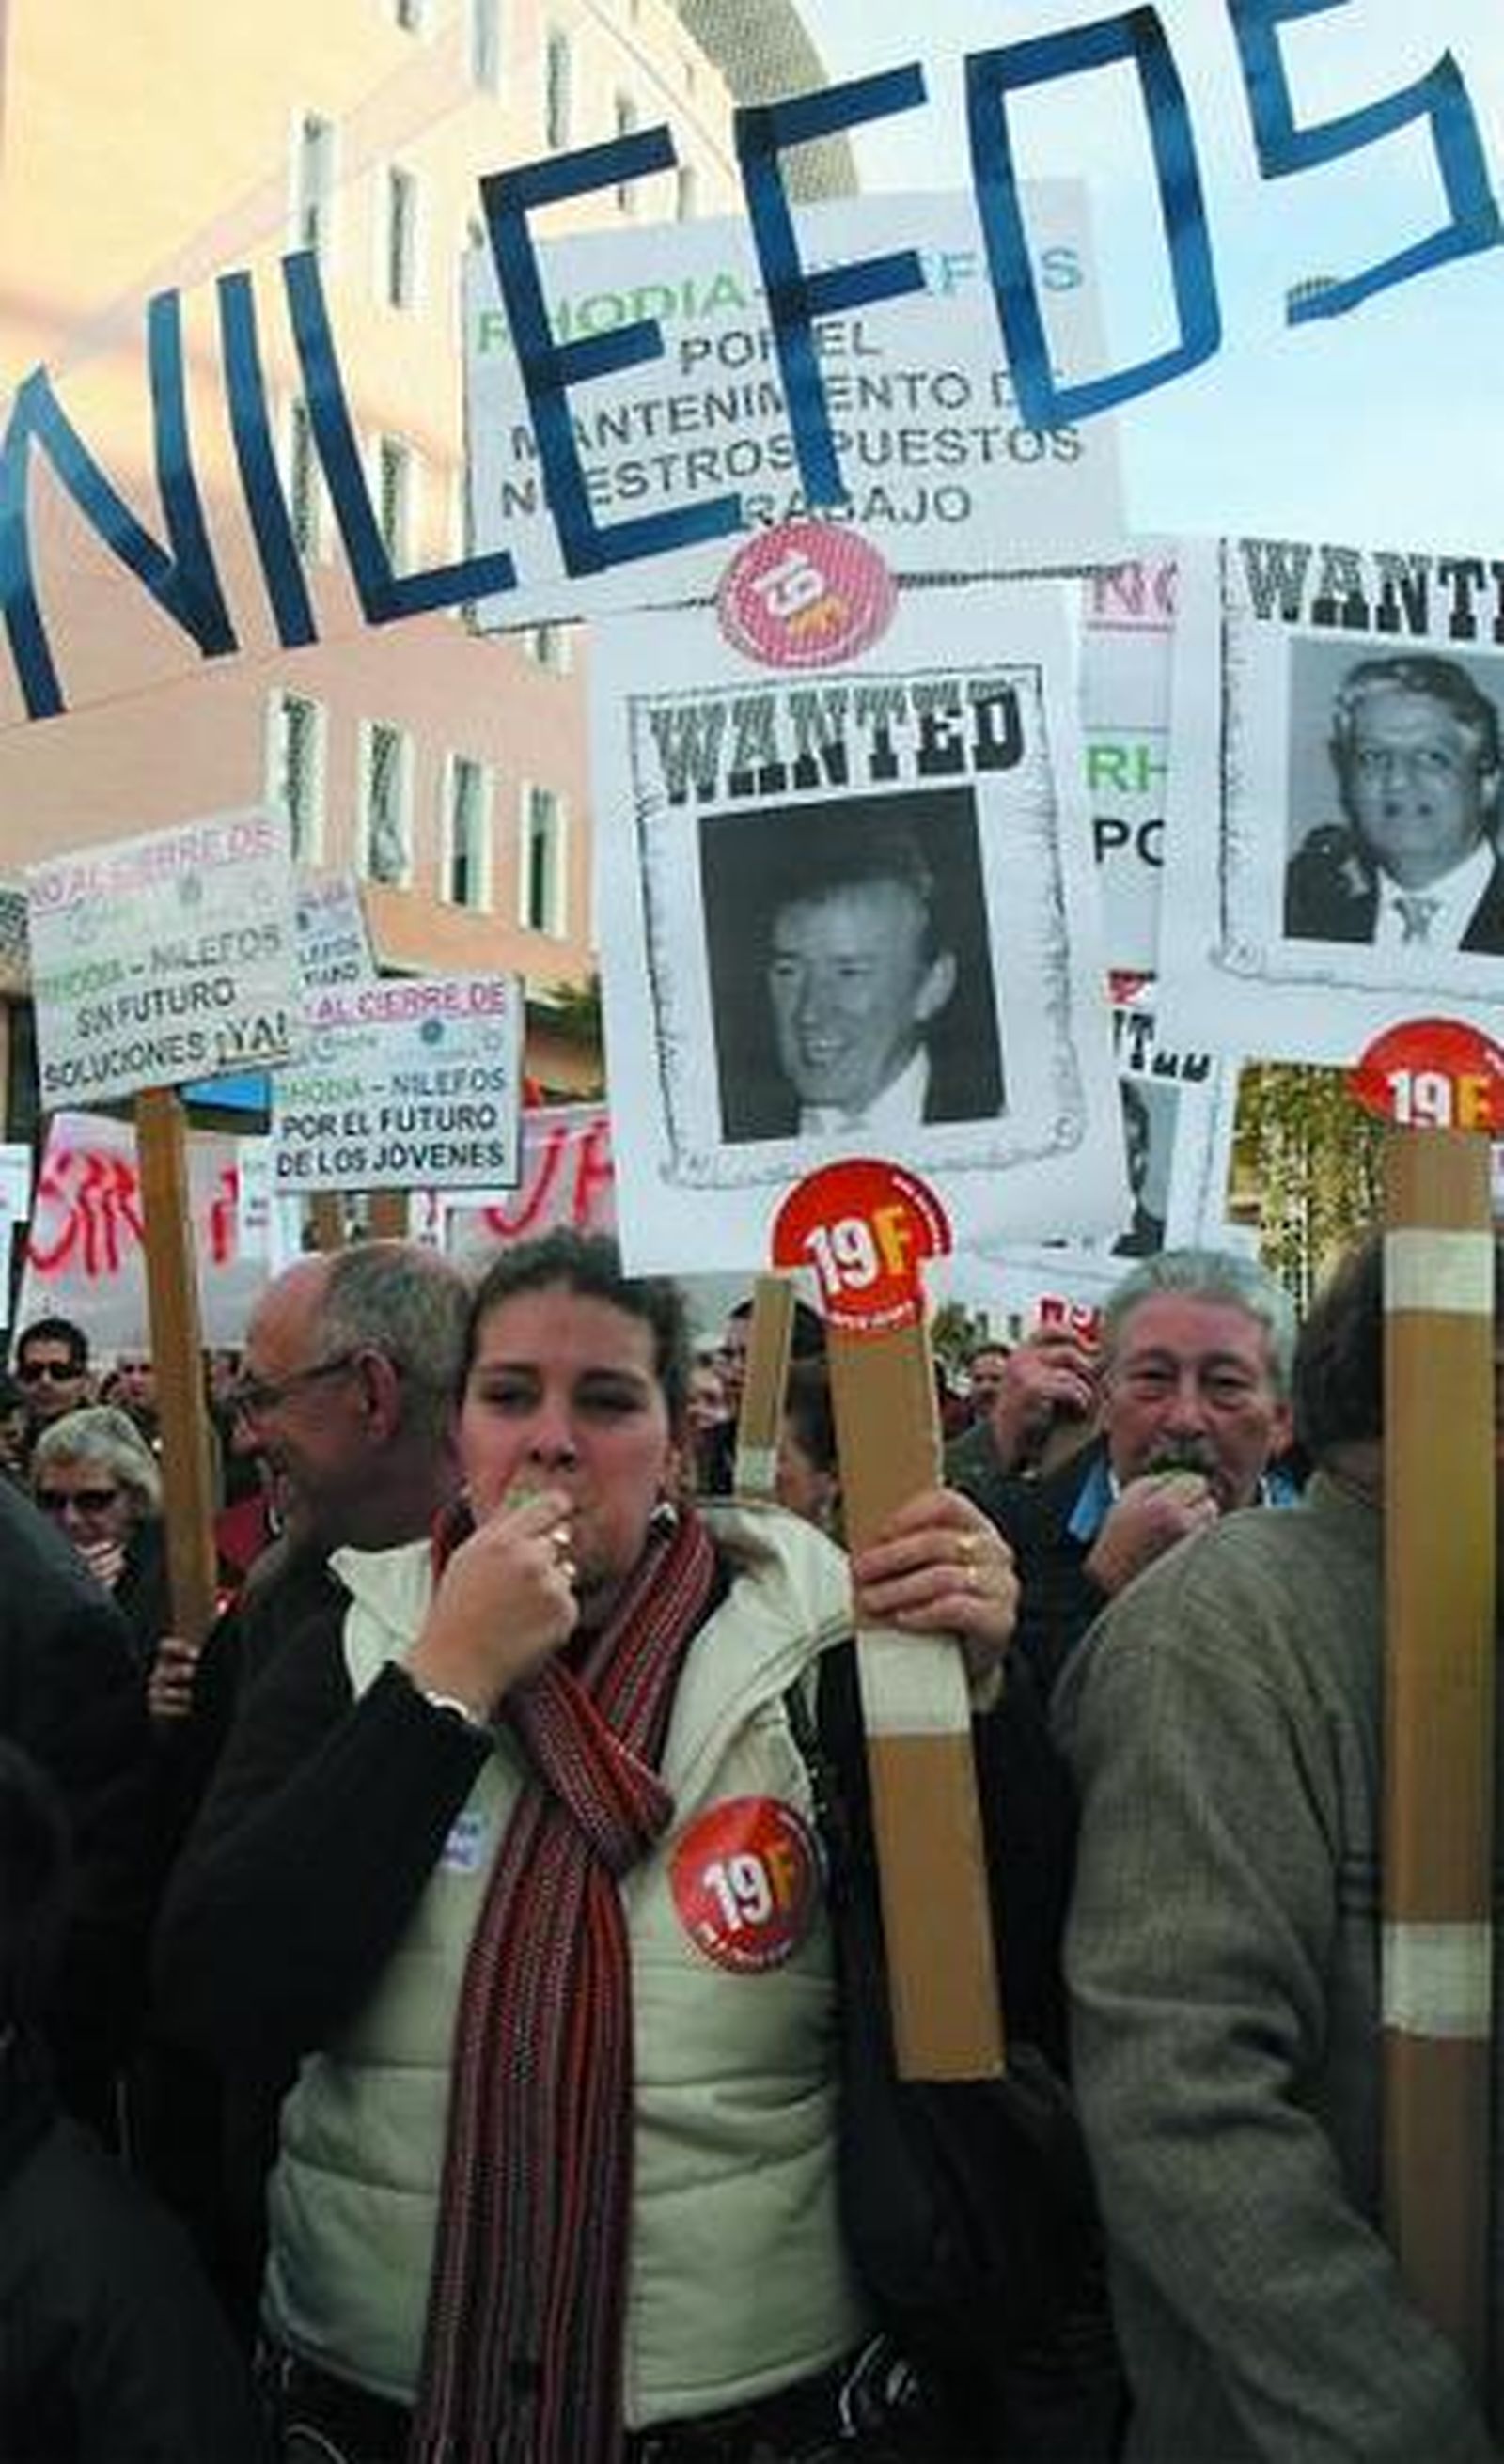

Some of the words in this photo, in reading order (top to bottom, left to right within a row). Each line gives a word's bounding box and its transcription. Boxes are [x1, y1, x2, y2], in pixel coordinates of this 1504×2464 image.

[0, 0, 1504, 721] NILEFOS
[681, 330, 773, 374] PO
[502, 432, 793, 518] NESTROS
[650, 678, 1026, 805] WANTED
[117, 975, 236, 1024] FUTURO
[44, 1030, 205, 1092] SOLUCIONES
[393, 1068, 505, 1097] NILEFOS
[281, 1115, 337, 1141] POR
[344, 1111, 372, 1137] EL
[380, 1104, 498, 1134] FUTURO
[276, 1151, 312, 1177] DE
[317, 1148, 368, 1176] LOS
[803, 1204, 912, 1294] 19F
[703, 1840, 793, 1930] 19F
